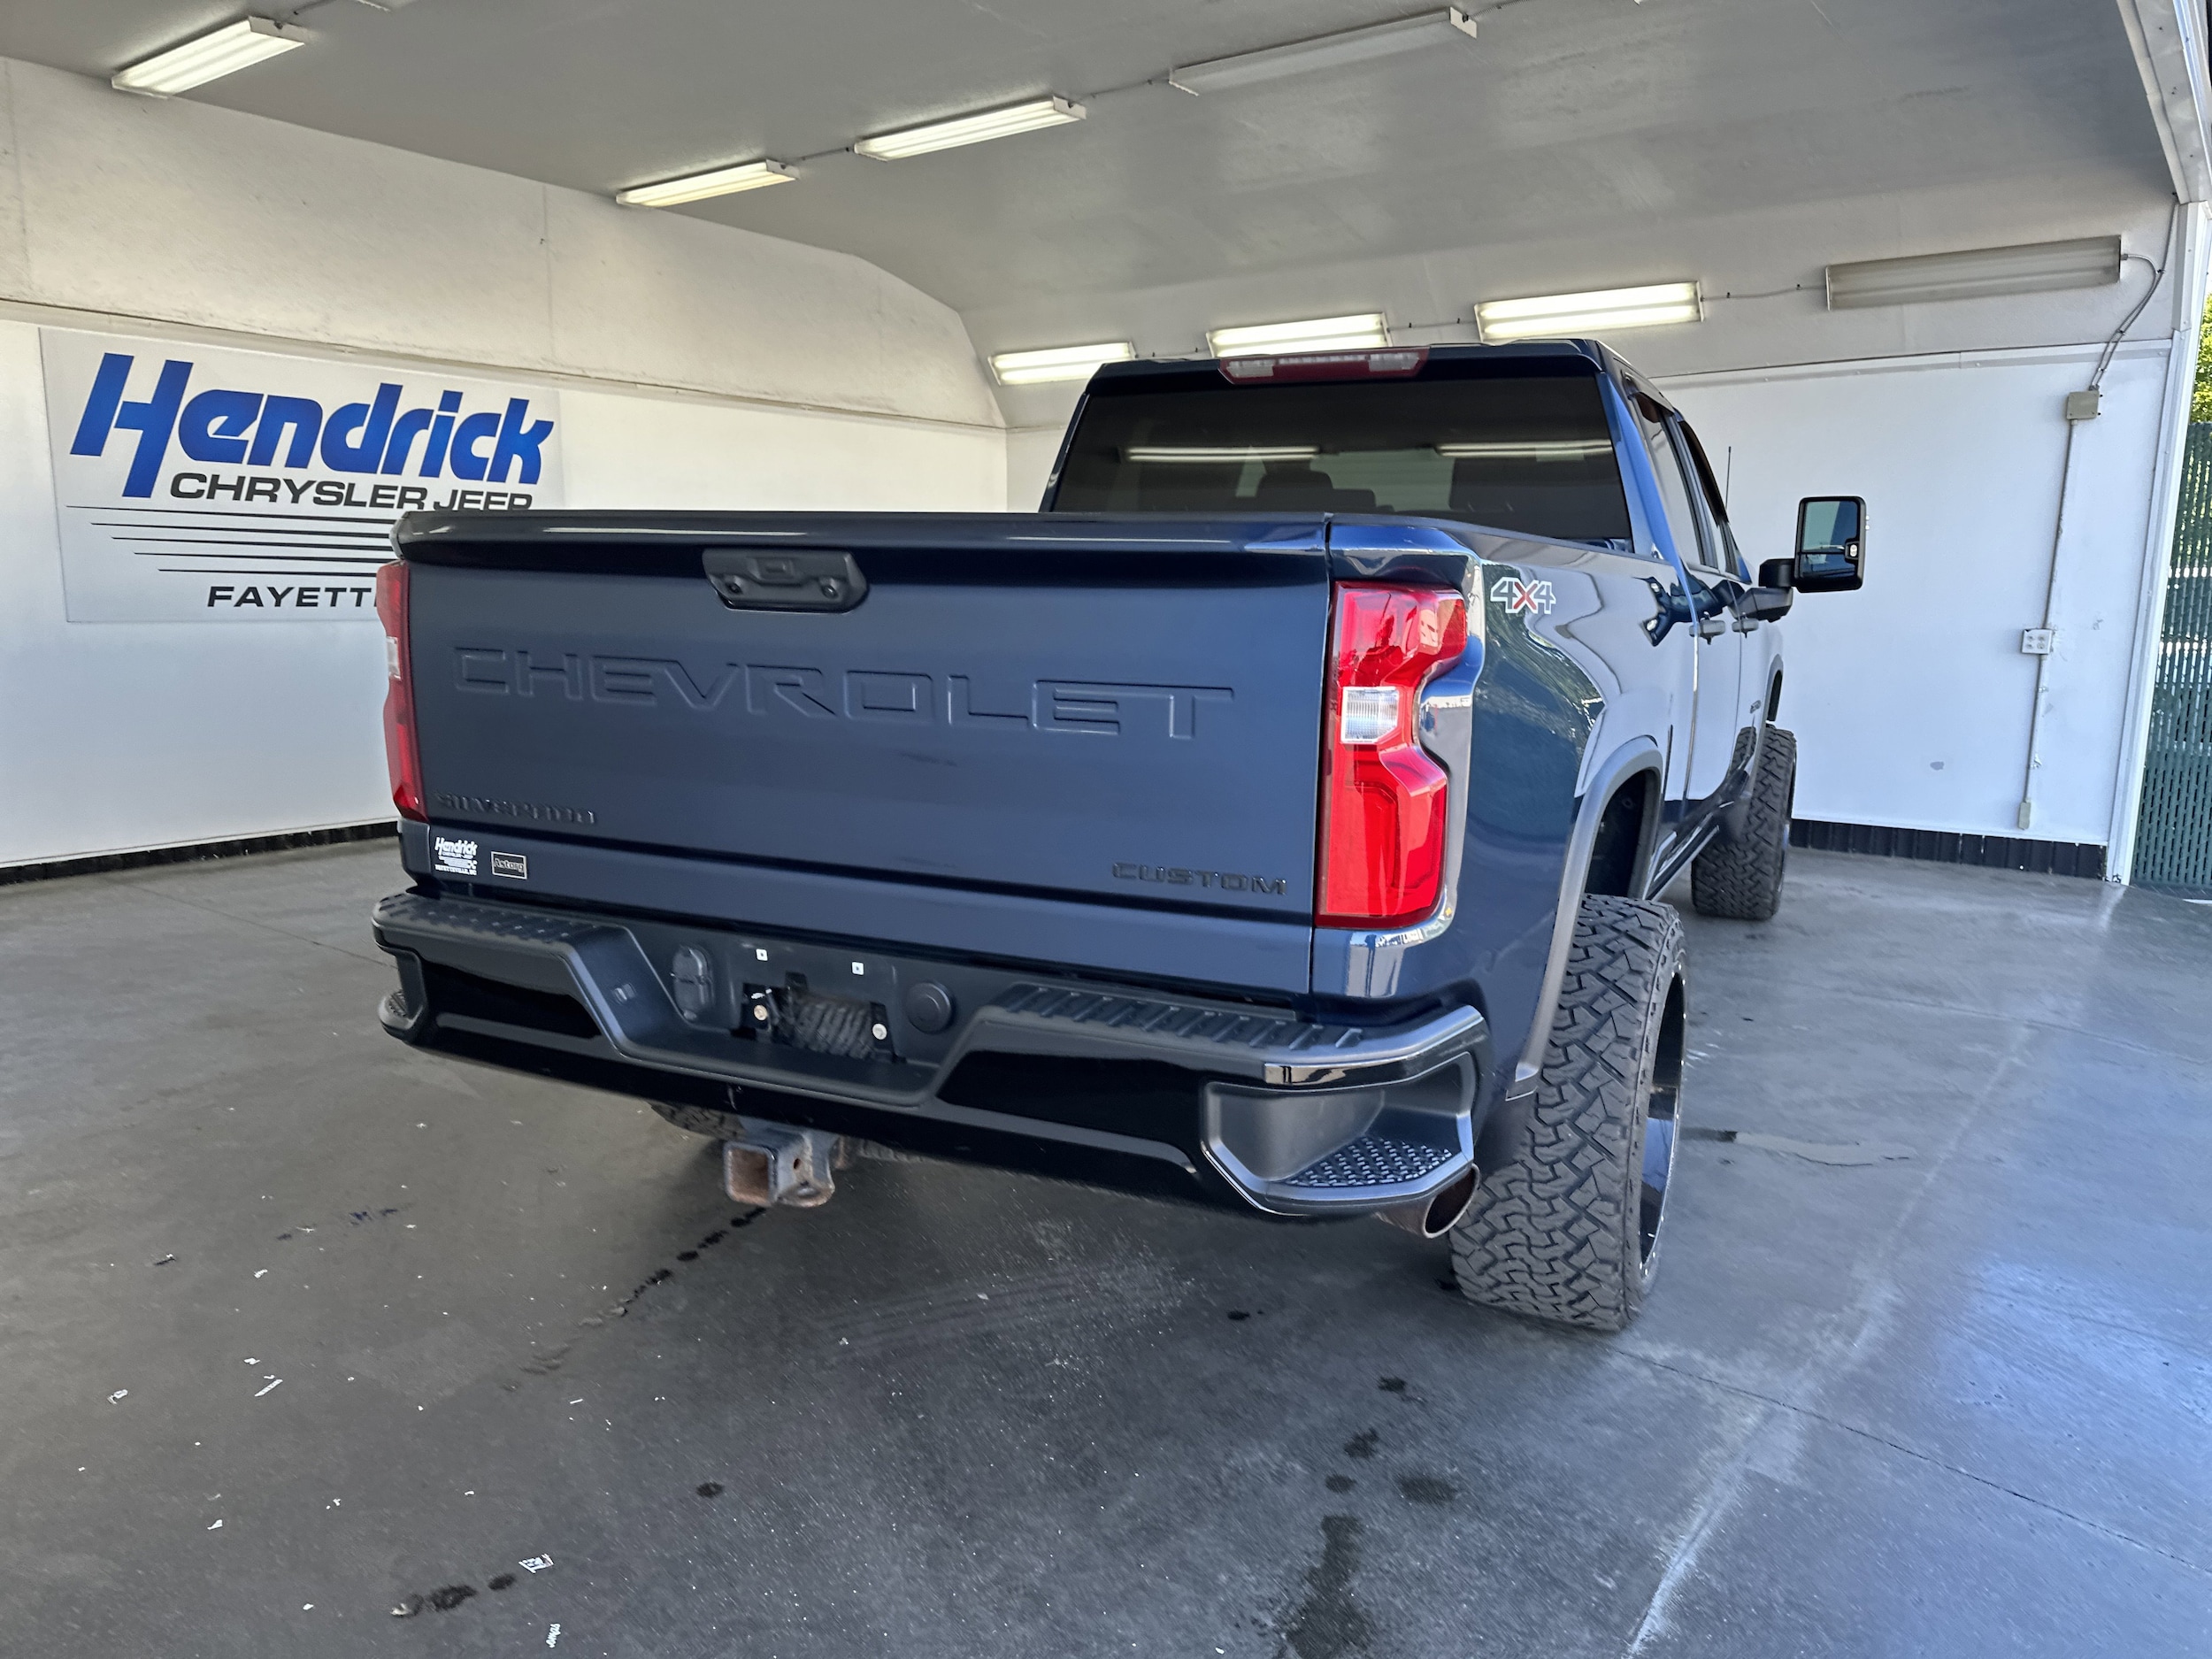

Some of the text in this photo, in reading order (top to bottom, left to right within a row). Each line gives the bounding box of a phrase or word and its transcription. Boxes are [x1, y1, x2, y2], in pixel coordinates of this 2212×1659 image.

[70, 352, 554, 498] Hendrick
[170, 472, 533, 511] CHRYSLER JEEP
[207, 586, 378, 608] FAYETT
[453, 646, 1235, 740] CHEVROLET
[434, 836, 478, 856] Hendrick
[1112, 862, 1287, 895] CUSTOM
